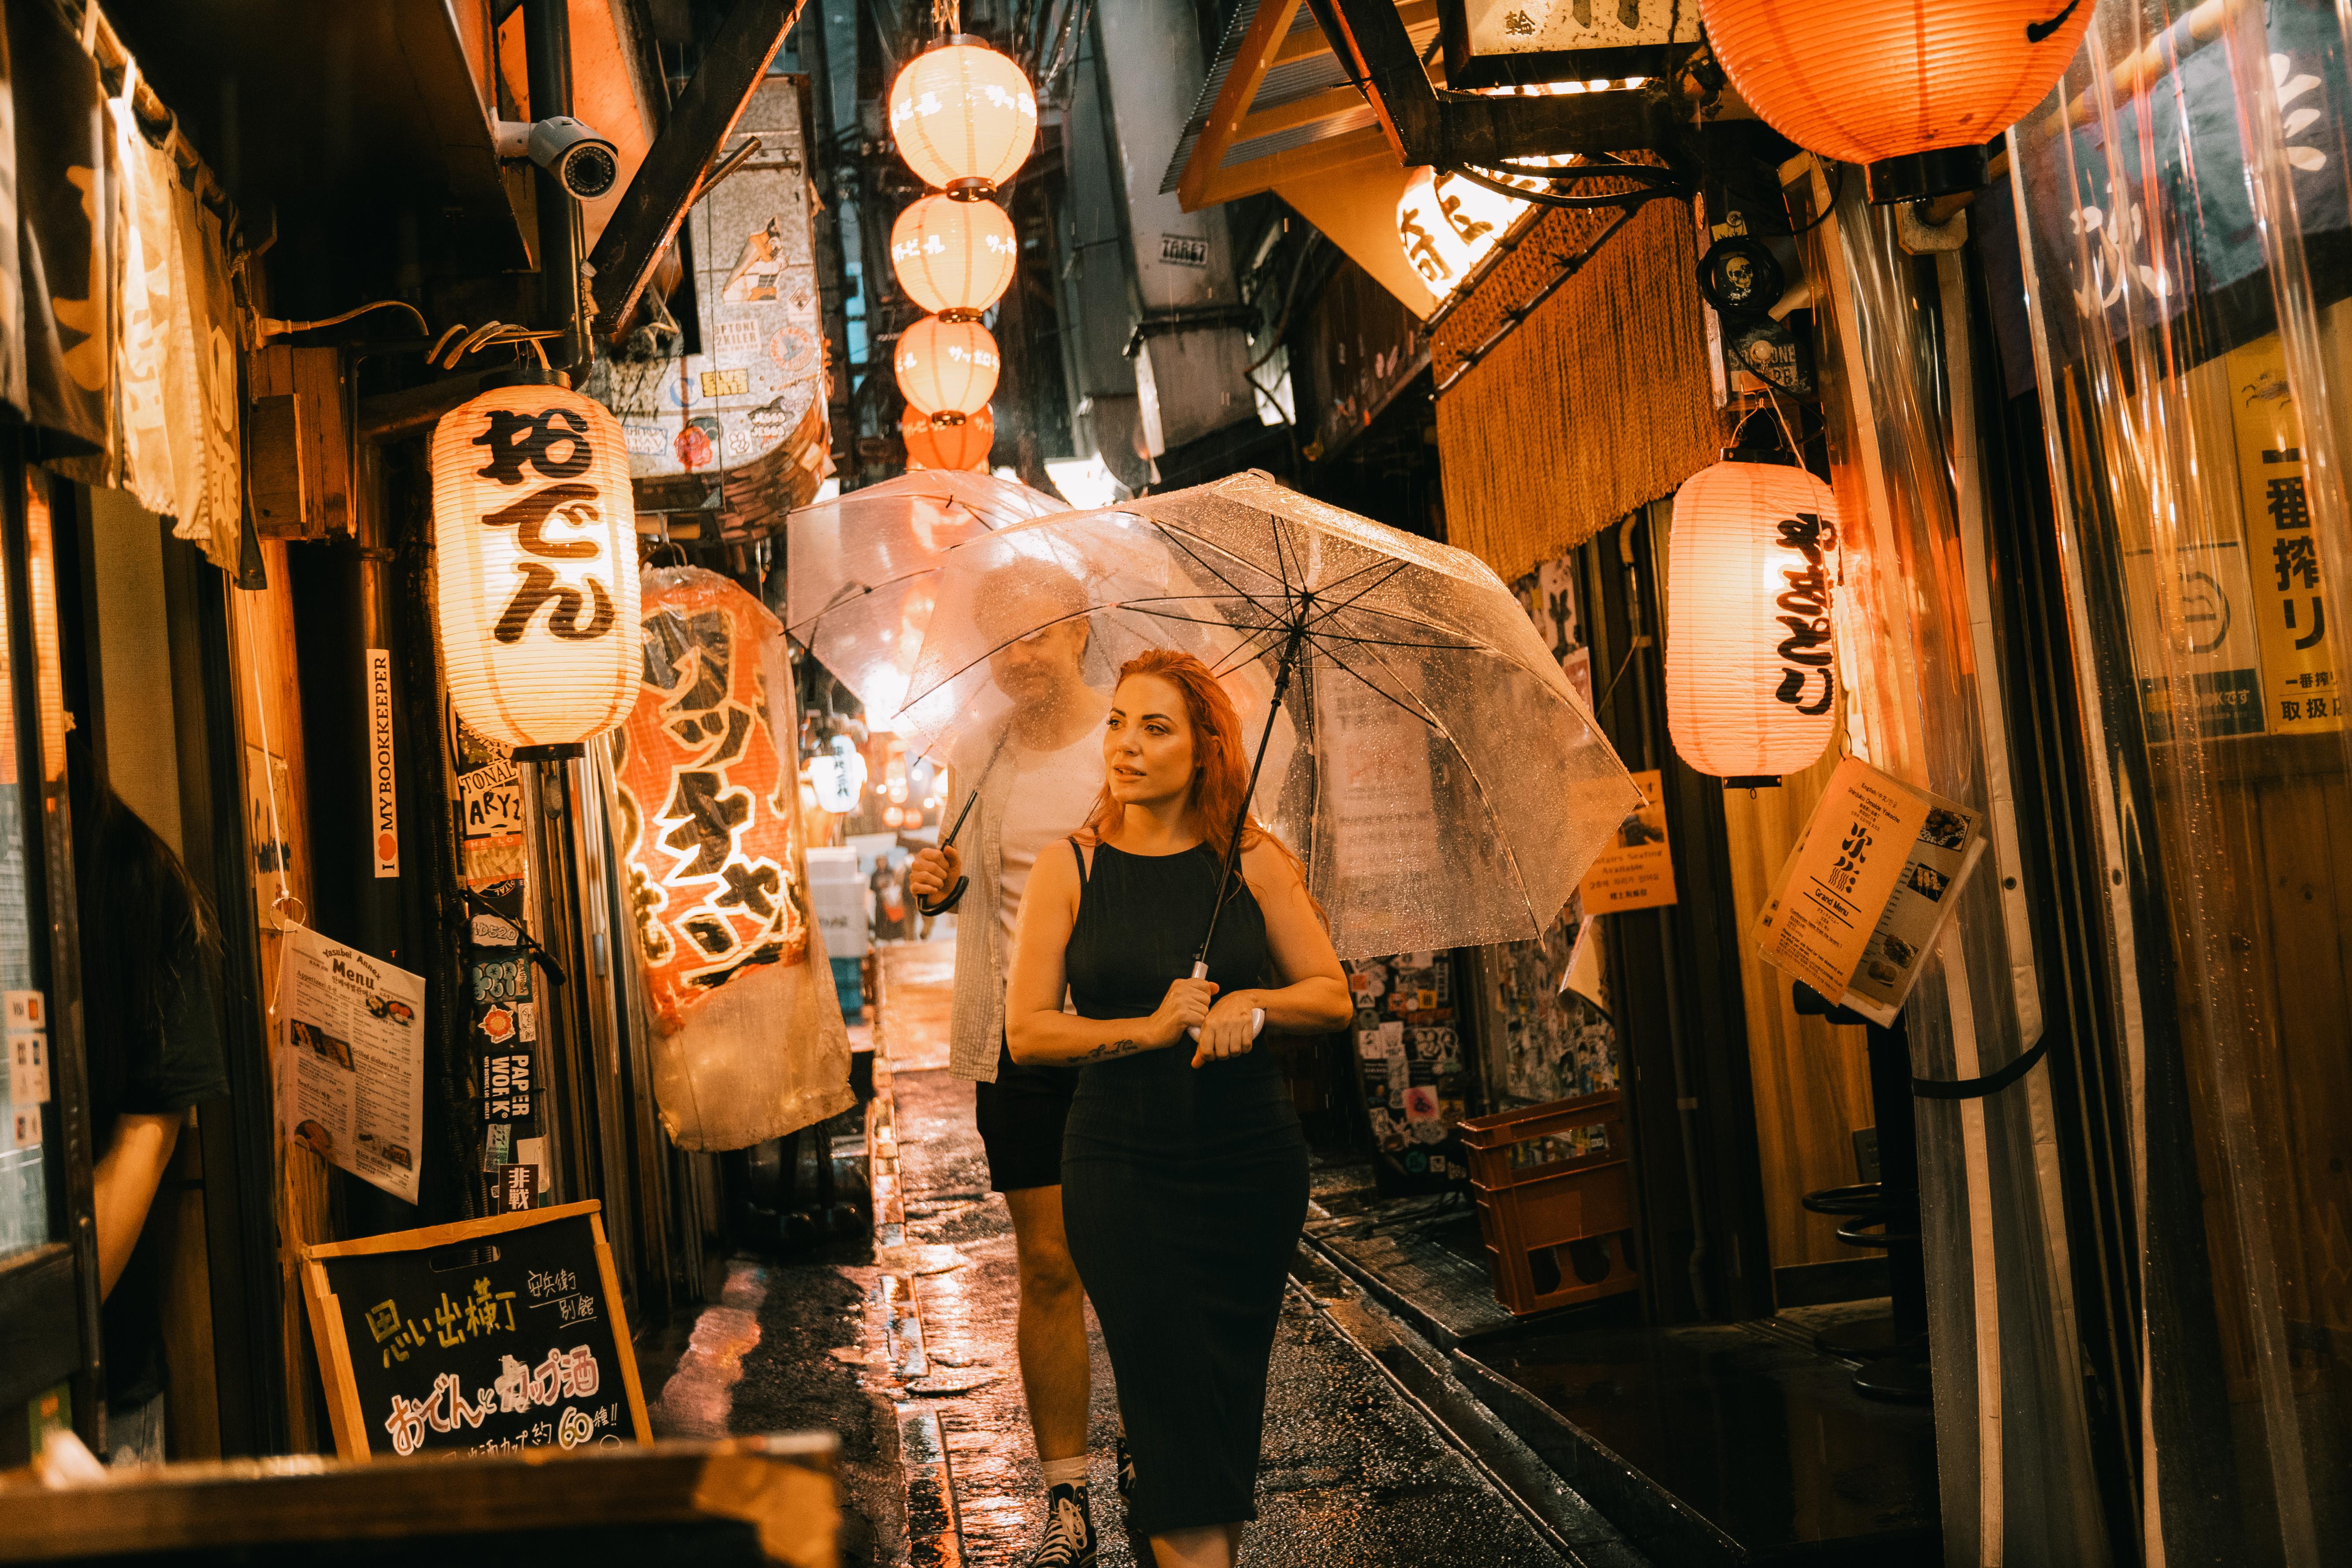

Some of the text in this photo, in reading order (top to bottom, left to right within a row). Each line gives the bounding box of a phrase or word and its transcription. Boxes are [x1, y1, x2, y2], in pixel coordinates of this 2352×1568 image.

[472, 408, 614, 640] おでん
[2262, 447, 2325, 651] 一番搾り
[375, 657, 392, 795] BOOKKEEPER
[461, 762, 516, 794] TONAL
[380, 796, 393, 832] MY
[1848, 787, 1900, 823] Shinjuku Omoide Yokocho
[471, 836, 514, 848] HELO
[1815, 888, 1849, 917] Grand Menu
[323, 948, 382, 981] Yasubei Annex
[332, 958, 375, 990] Menu
[352, 1047, 370, 1060] Grilled
[512, 1055, 529, 1116] PAPER
[365, 1277, 517, 1368] 思い出横丁
